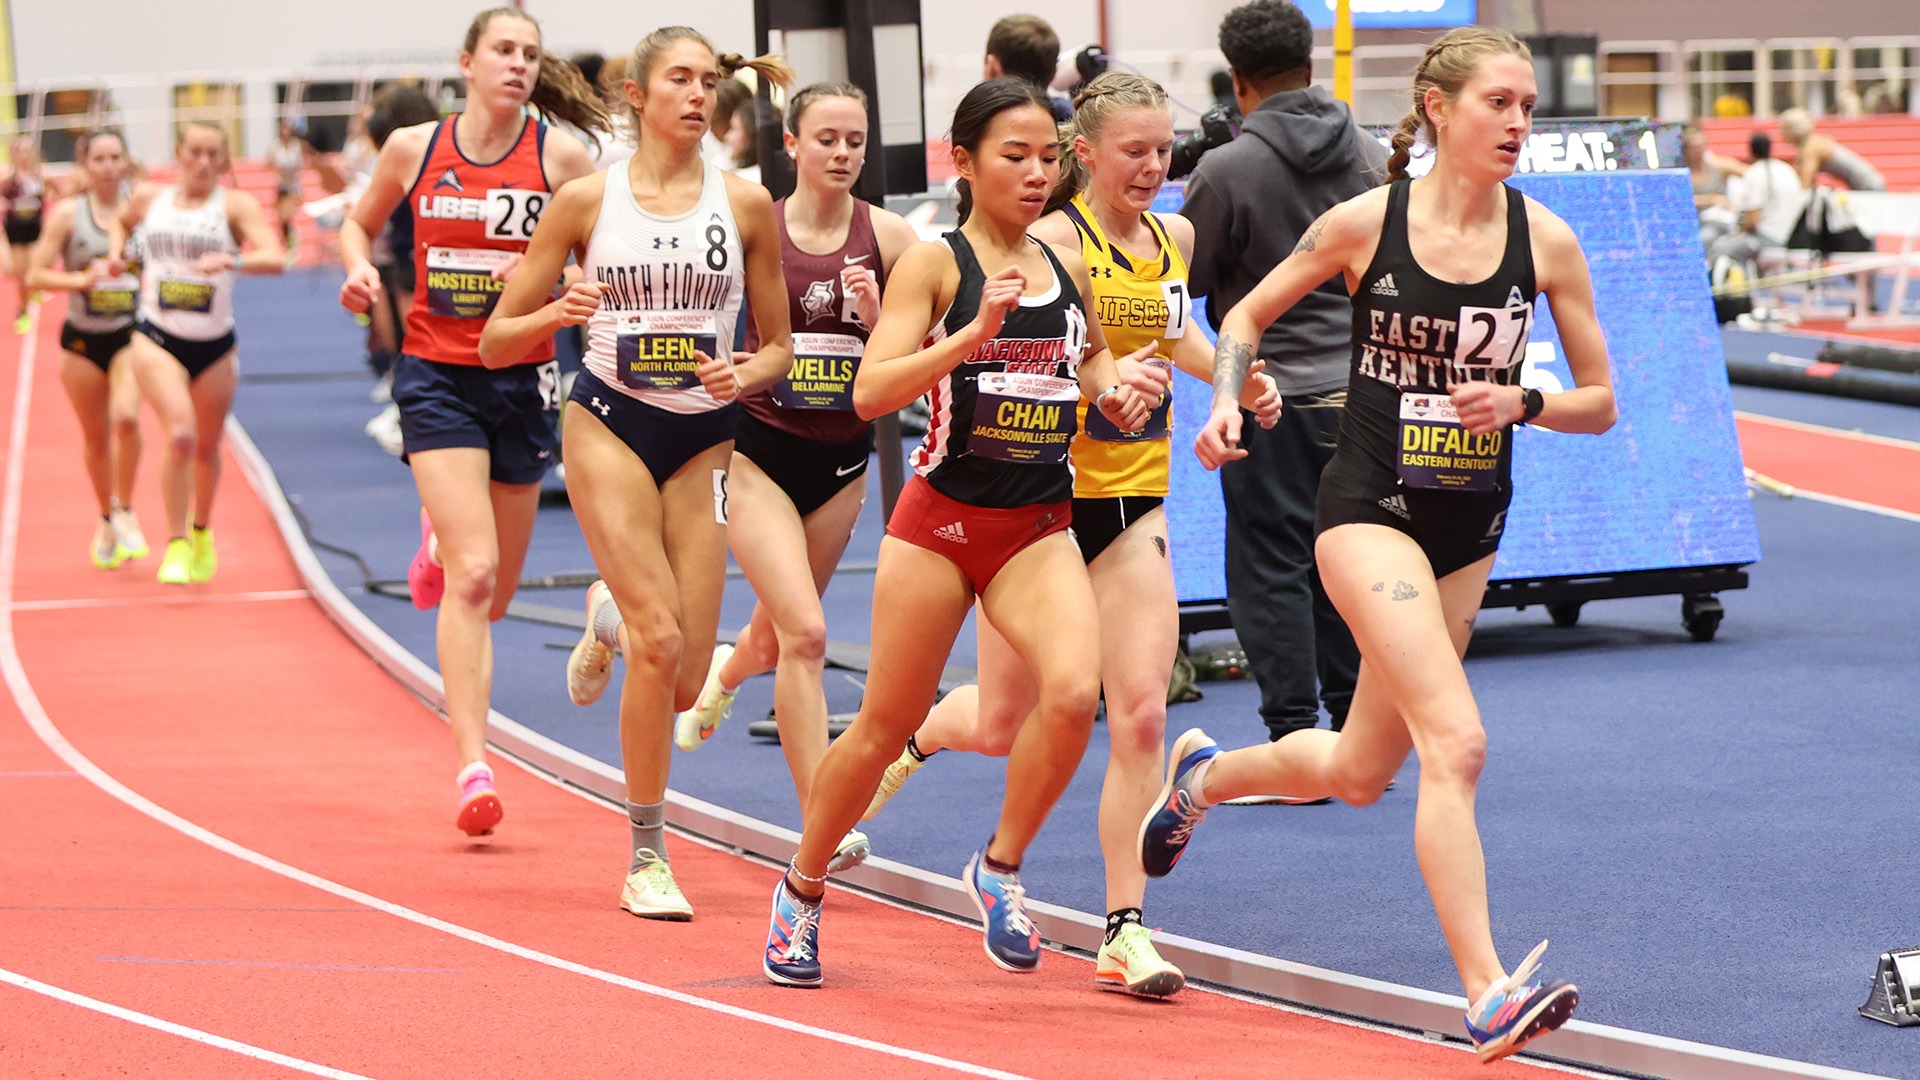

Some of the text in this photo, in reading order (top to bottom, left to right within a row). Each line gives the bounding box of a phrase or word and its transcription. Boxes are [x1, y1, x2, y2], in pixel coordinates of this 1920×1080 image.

[1518, 130, 1659, 173] HEAT: 1
[494, 194, 543, 237] 28
[705, 224, 728, 271] 8
[1096, 296, 1169, 328] IPSCO
[1169, 284, 1183, 328] 7
[638, 337, 695, 360] LEEN
[1464, 309, 1528, 365] 27
[630, 361, 661, 372] NORTH
[786, 358, 853, 382] WELLS
[792, 382, 845, 393] BELLARMINE
[996, 401, 1061, 430] CHAN
[972, 425, 1068, 444] JACKSONVILLE STATE
[1402, 424, 1502, 456] DIFALCO
[1402, 453, 1498, 470] EASTERN KENTUCKY
[933, 529, 968, 544] adidas
